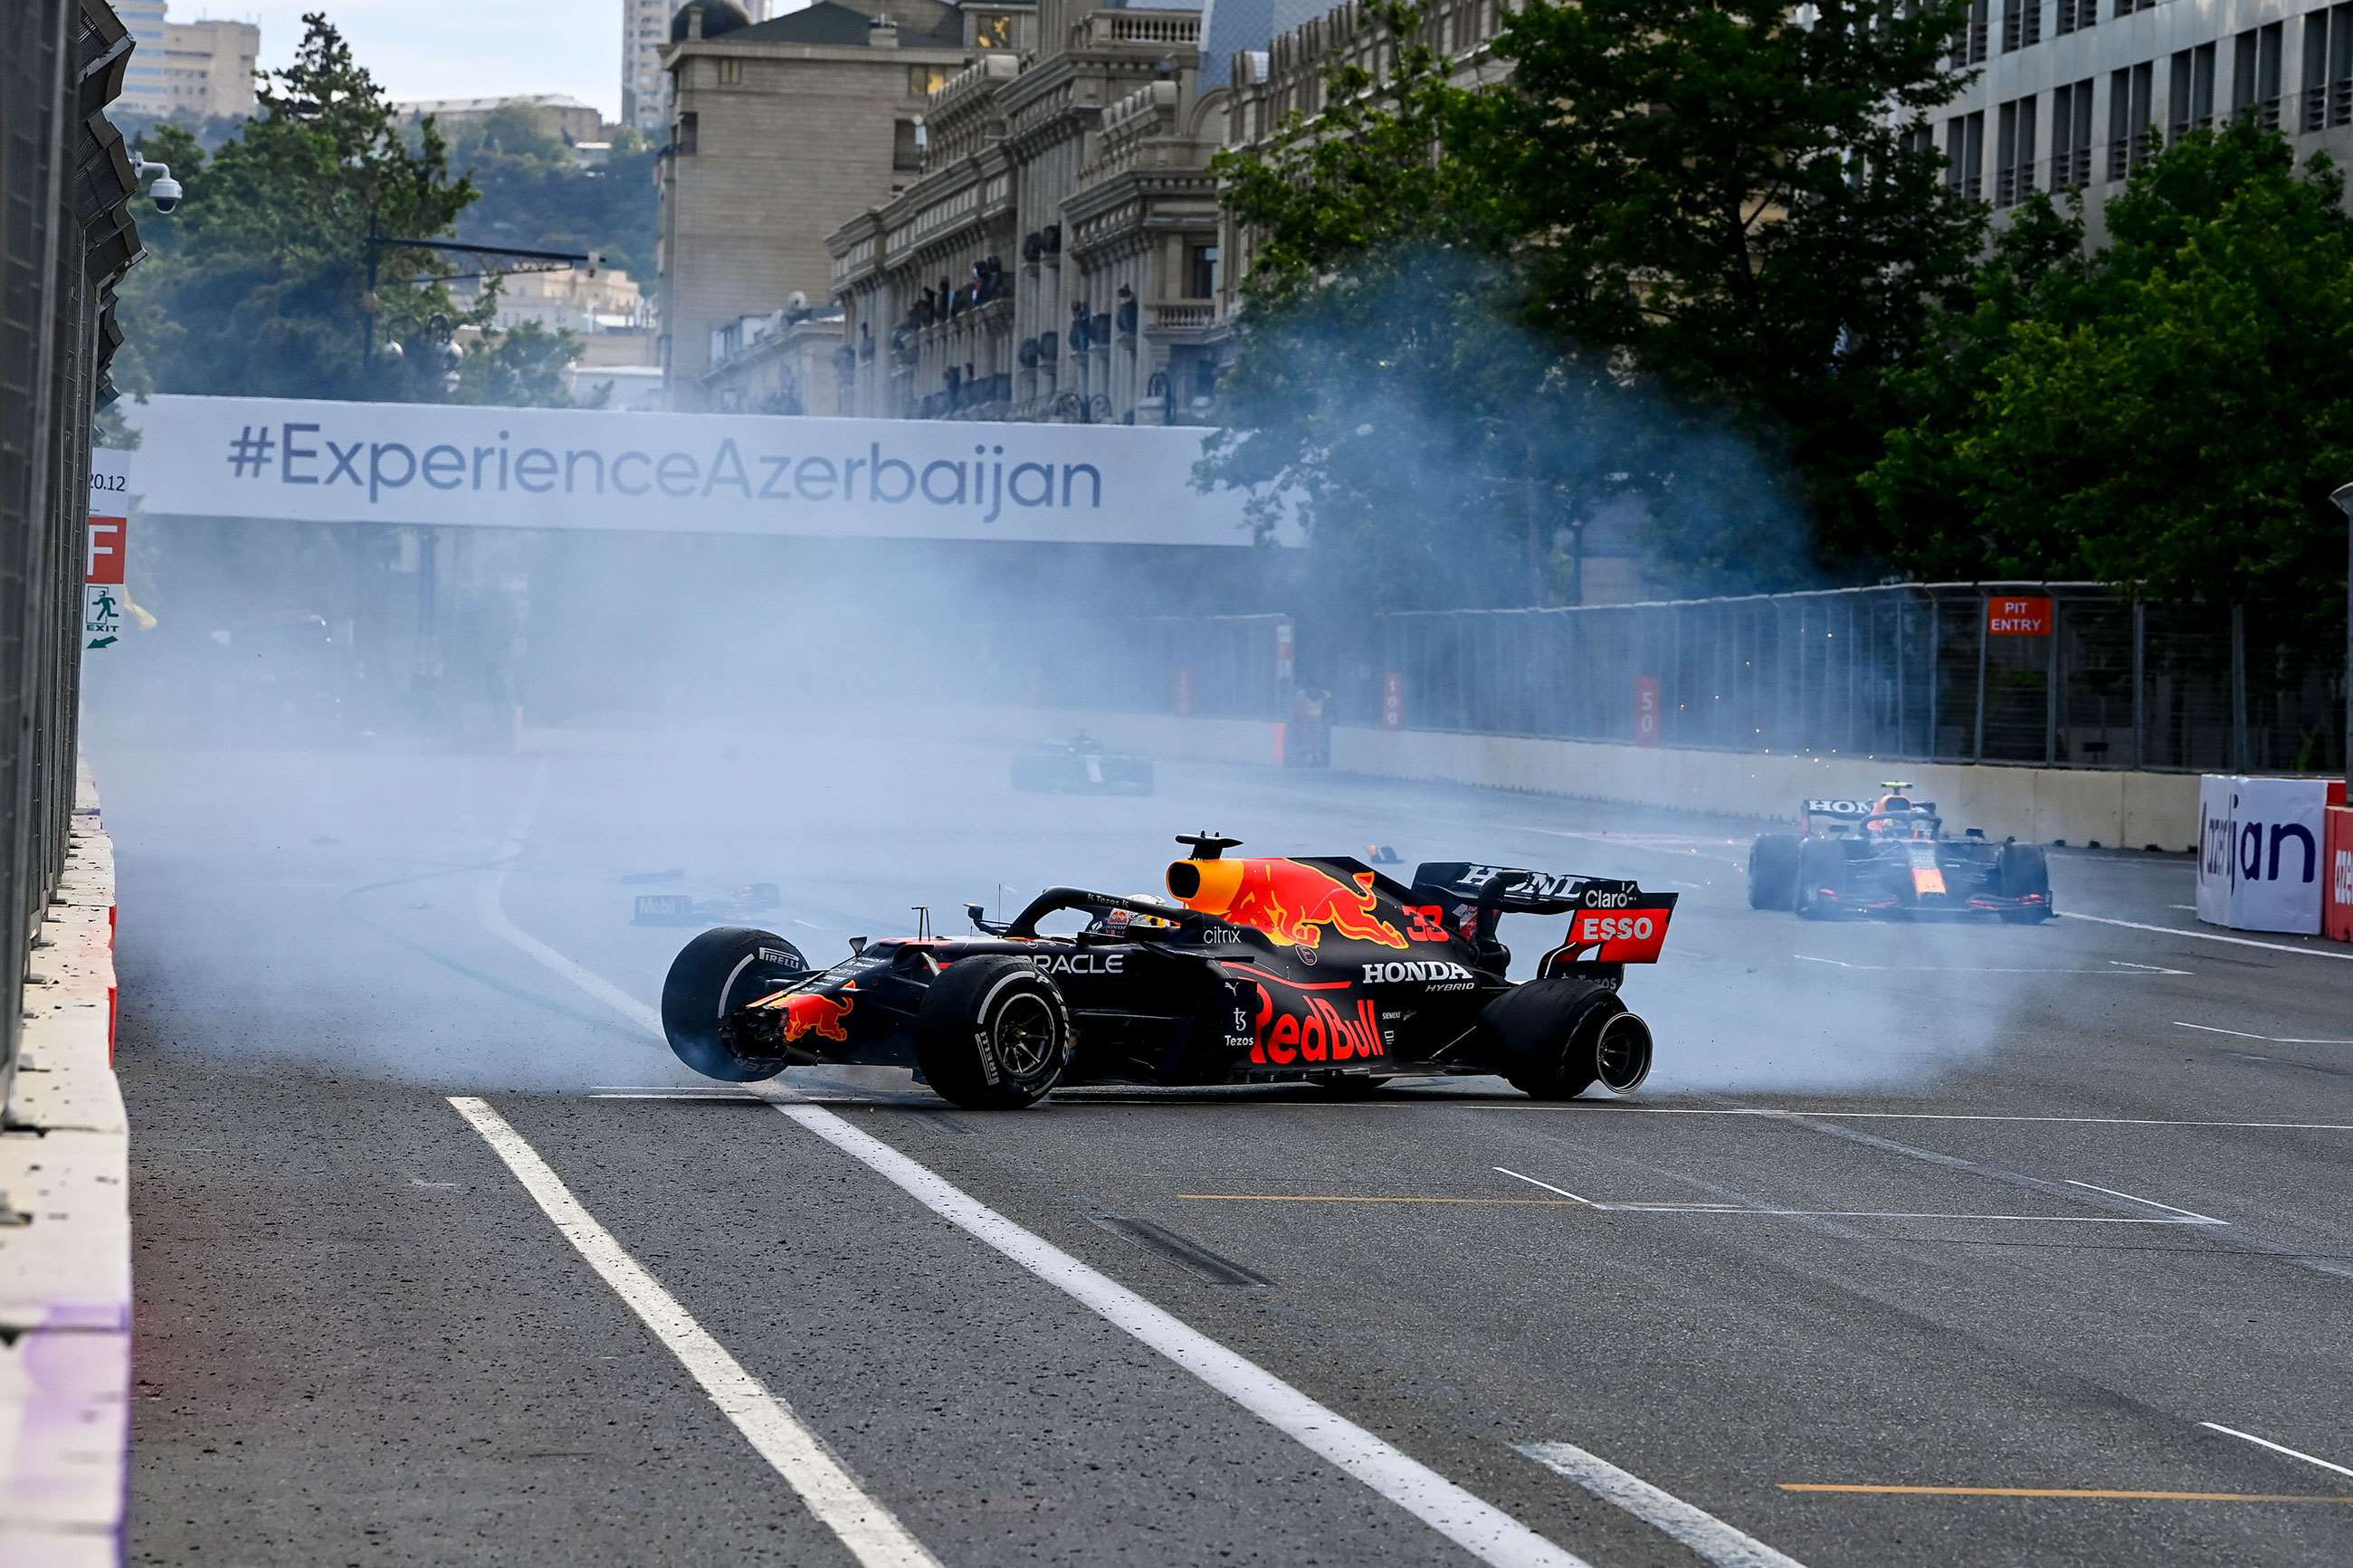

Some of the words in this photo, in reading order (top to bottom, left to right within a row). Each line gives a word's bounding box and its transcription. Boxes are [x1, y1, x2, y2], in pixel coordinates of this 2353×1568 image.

[226, 423, 1102, 525] #ExperienceAzerbaijan
[2005, 602, 2027, 613] PIT
[87, 624, 119, 632] EXIT
[1991, 619, 2042, 631] ENTRY
[1641, 691, 1653, 733] 50
[1585, 889, 1628, 908] Claro
[1204, 927, 1241, 944] citrix
[1584, 917, 1653, 940] ESSO
[759, 946, 800, 970] PIRELLI
[1362, 961, 1473, 984] HONDA
[1425, 983, 1475, 992] HYBRID
[1224, 1035, 1254, 1047] Tezos
[975, 1031, 1000, 1086] PIRELLI
